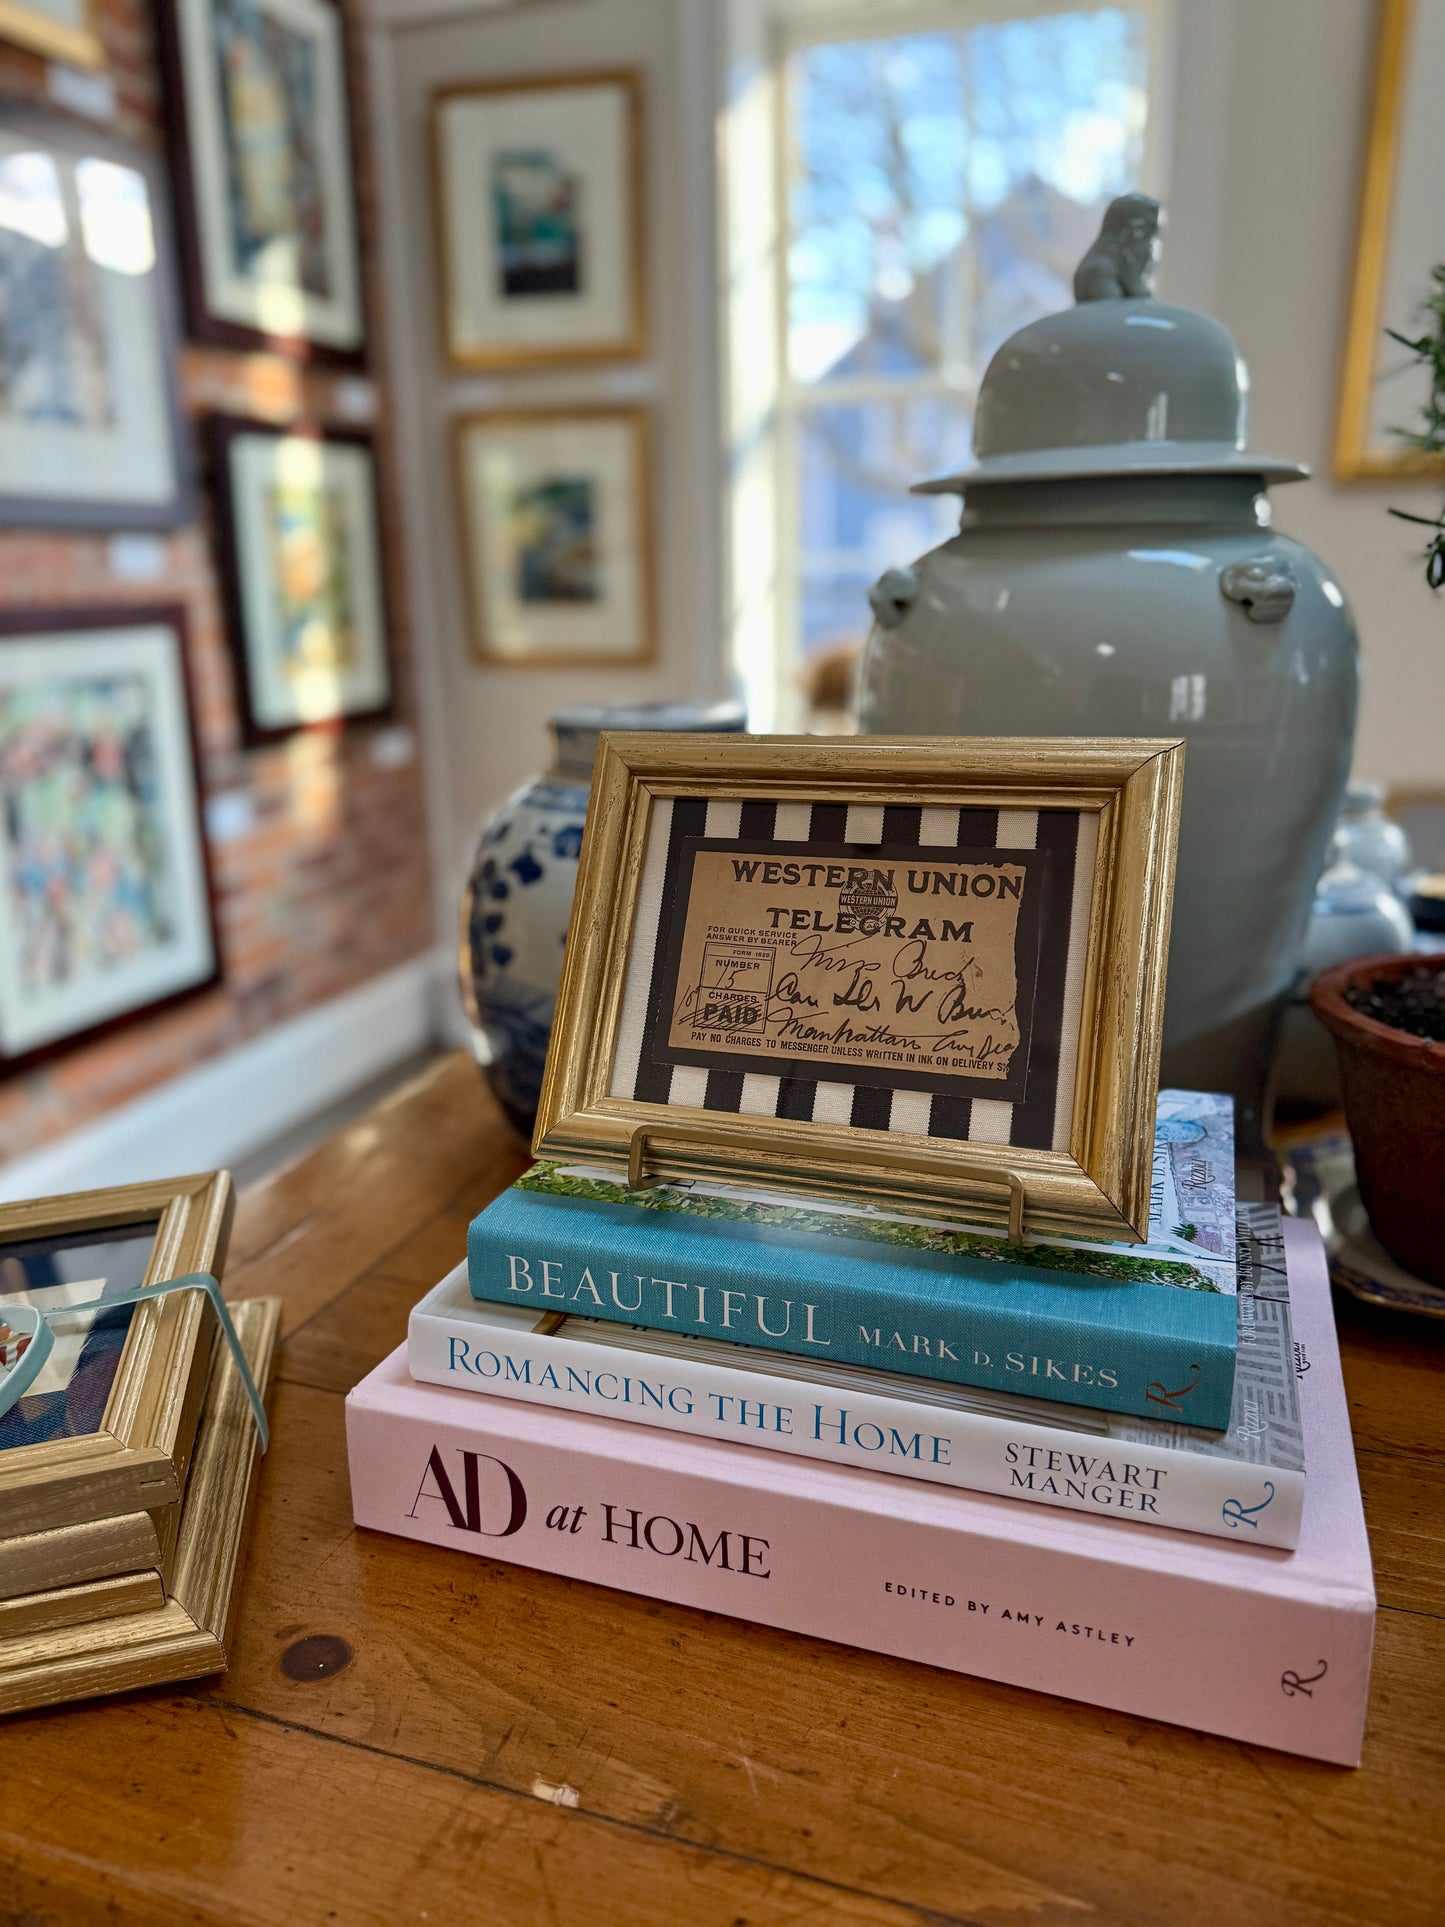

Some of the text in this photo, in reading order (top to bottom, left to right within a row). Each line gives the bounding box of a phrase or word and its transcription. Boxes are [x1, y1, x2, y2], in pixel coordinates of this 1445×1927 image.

[731, 860, 1023, 900] WESTERN UNION
[840, 894, 897, 907] WESTERN UNION
[706, 933, 798, 947] ANSWER BY BEARER
[708, 925, 798, 939] FOR QUICK SERVICE
[765, 907, 974, 943] TELEGRAM
[715, 959, 760, 970] NUMBER
[703, 1003, 759, 1025] PAID
[708, 991, 758, 1003] CHARGES
[691, 1032, 707, 1042] PAY
[710, 1033, 722, 1043] NO
[726, 1035, 762, 1047] CHARGES
[766, 1039, 776, 1049] TO
[780, 1040, 828, 1053] MESSENGER
[831, 1045, 863, 1057] UNLESS
[866, 1049, 903, 1062] WRITTEN
[906, 1053, 915, 1063] IN
[918, 1054, 933, 1065] INK
[936, 1056, 948, 1066] ON
[952, 1057, 994, 1071] DELIVERY
[1148, 1180, 1164, 1225] MARK
[1236, 1246, 1254, 1278] BUNNY
[1239, 1280, 1254, 1291] BY
[506, 1255, 1119, 1390] BEAUTIFUL MARK D. SIKES
[1239, 1292, 1257, 1346] FOREWORD
[1144, 1363, 1200, 1413] R
[446, 1336, 1168, 1490] ROMANCING THE HOME STEWART
[1009, 1467, 1161, 1515] MANGER
[1222, 1481, 1275, 1530] R
[404, 1443, 772, 1580] AD at HOME
[884, 1581, 1137, 1648] EDITED BY AMY ASTLEY
[1280, 1659, 1328, 1699] R
